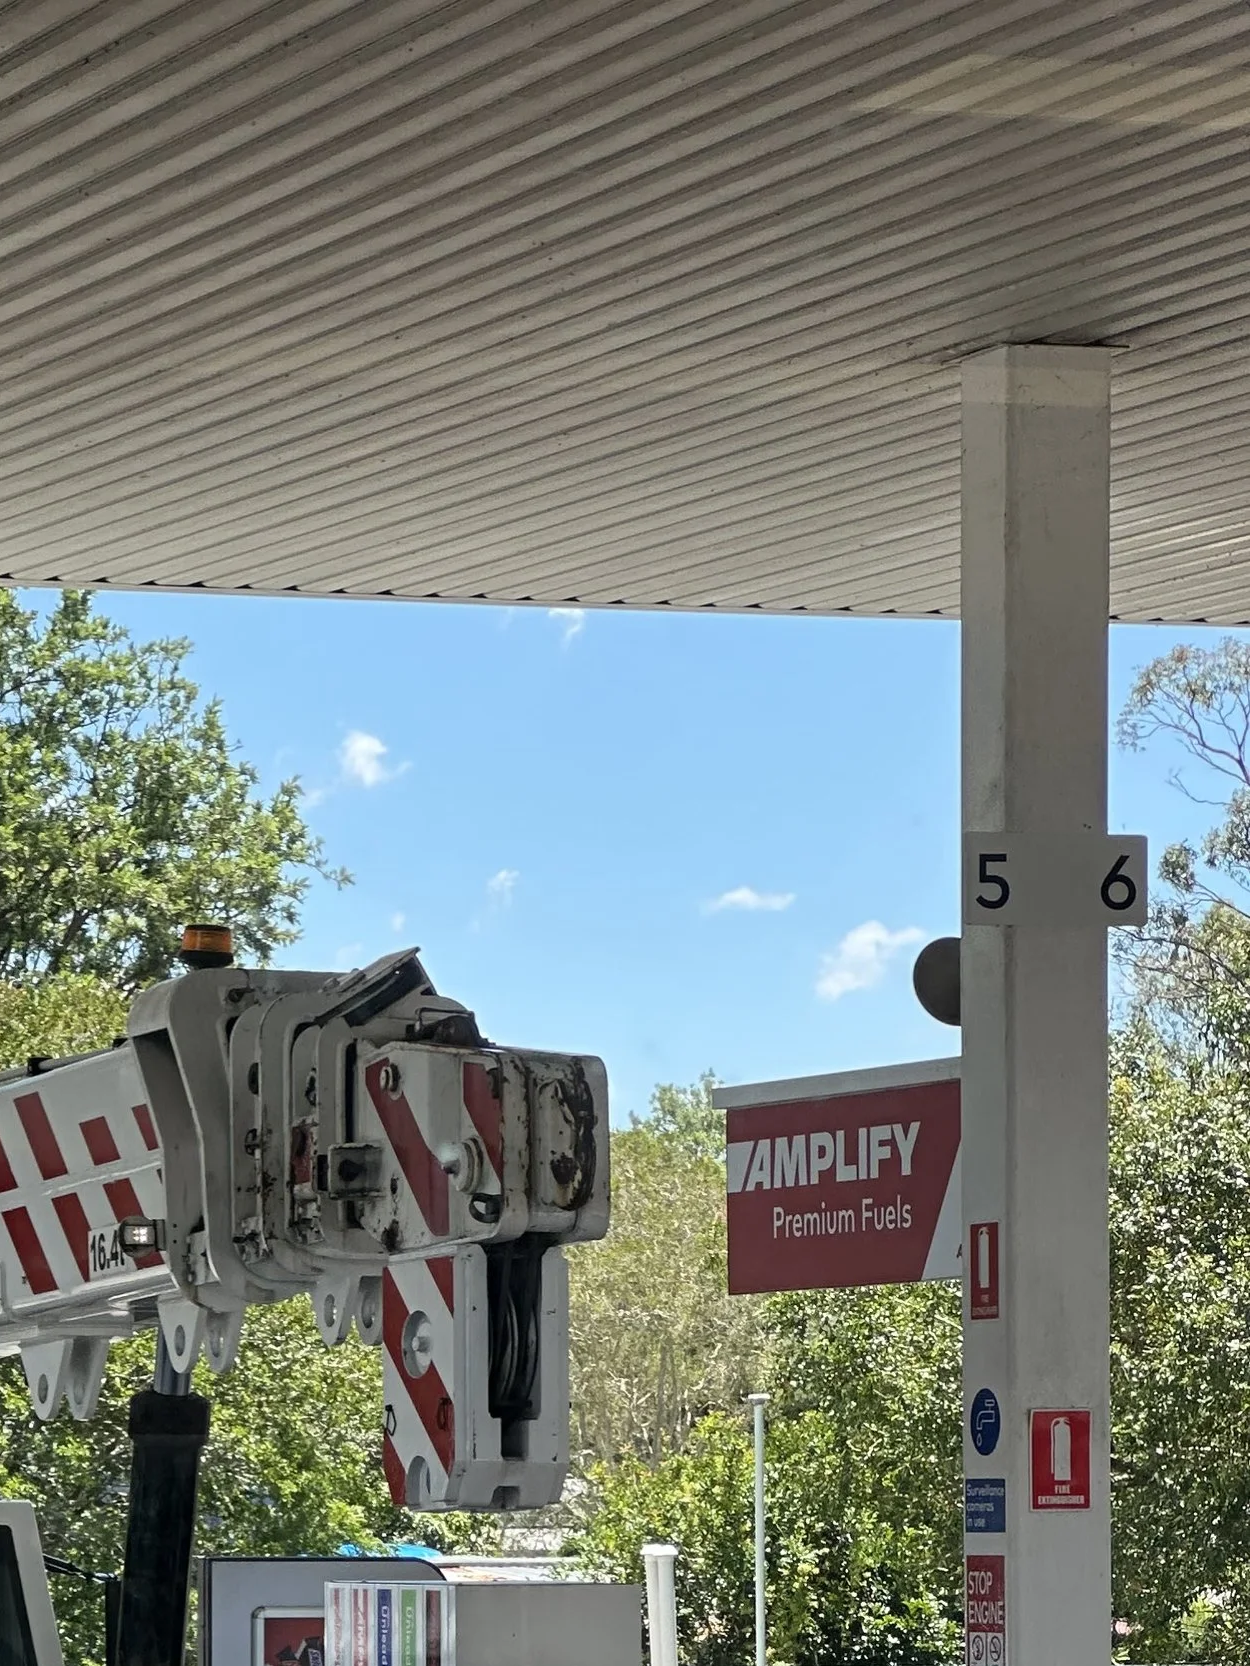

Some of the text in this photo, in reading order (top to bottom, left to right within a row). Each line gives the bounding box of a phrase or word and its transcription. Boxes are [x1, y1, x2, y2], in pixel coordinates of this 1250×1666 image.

[976, 853, 1010, 909] 5
[1101, 854, 1137, 911] 6
[745, 1121, 921, 1191] AMPLIFY
[773, 1195, 912, 1239] Premium Fuels
[966, 1484, 1005, 1496] Surveillance
[1054, 1485, 1070, 1494] FIRE
[968, 1571, 993, 1595] STOP
[968, 1600, 1004, 1625] ENGINE
